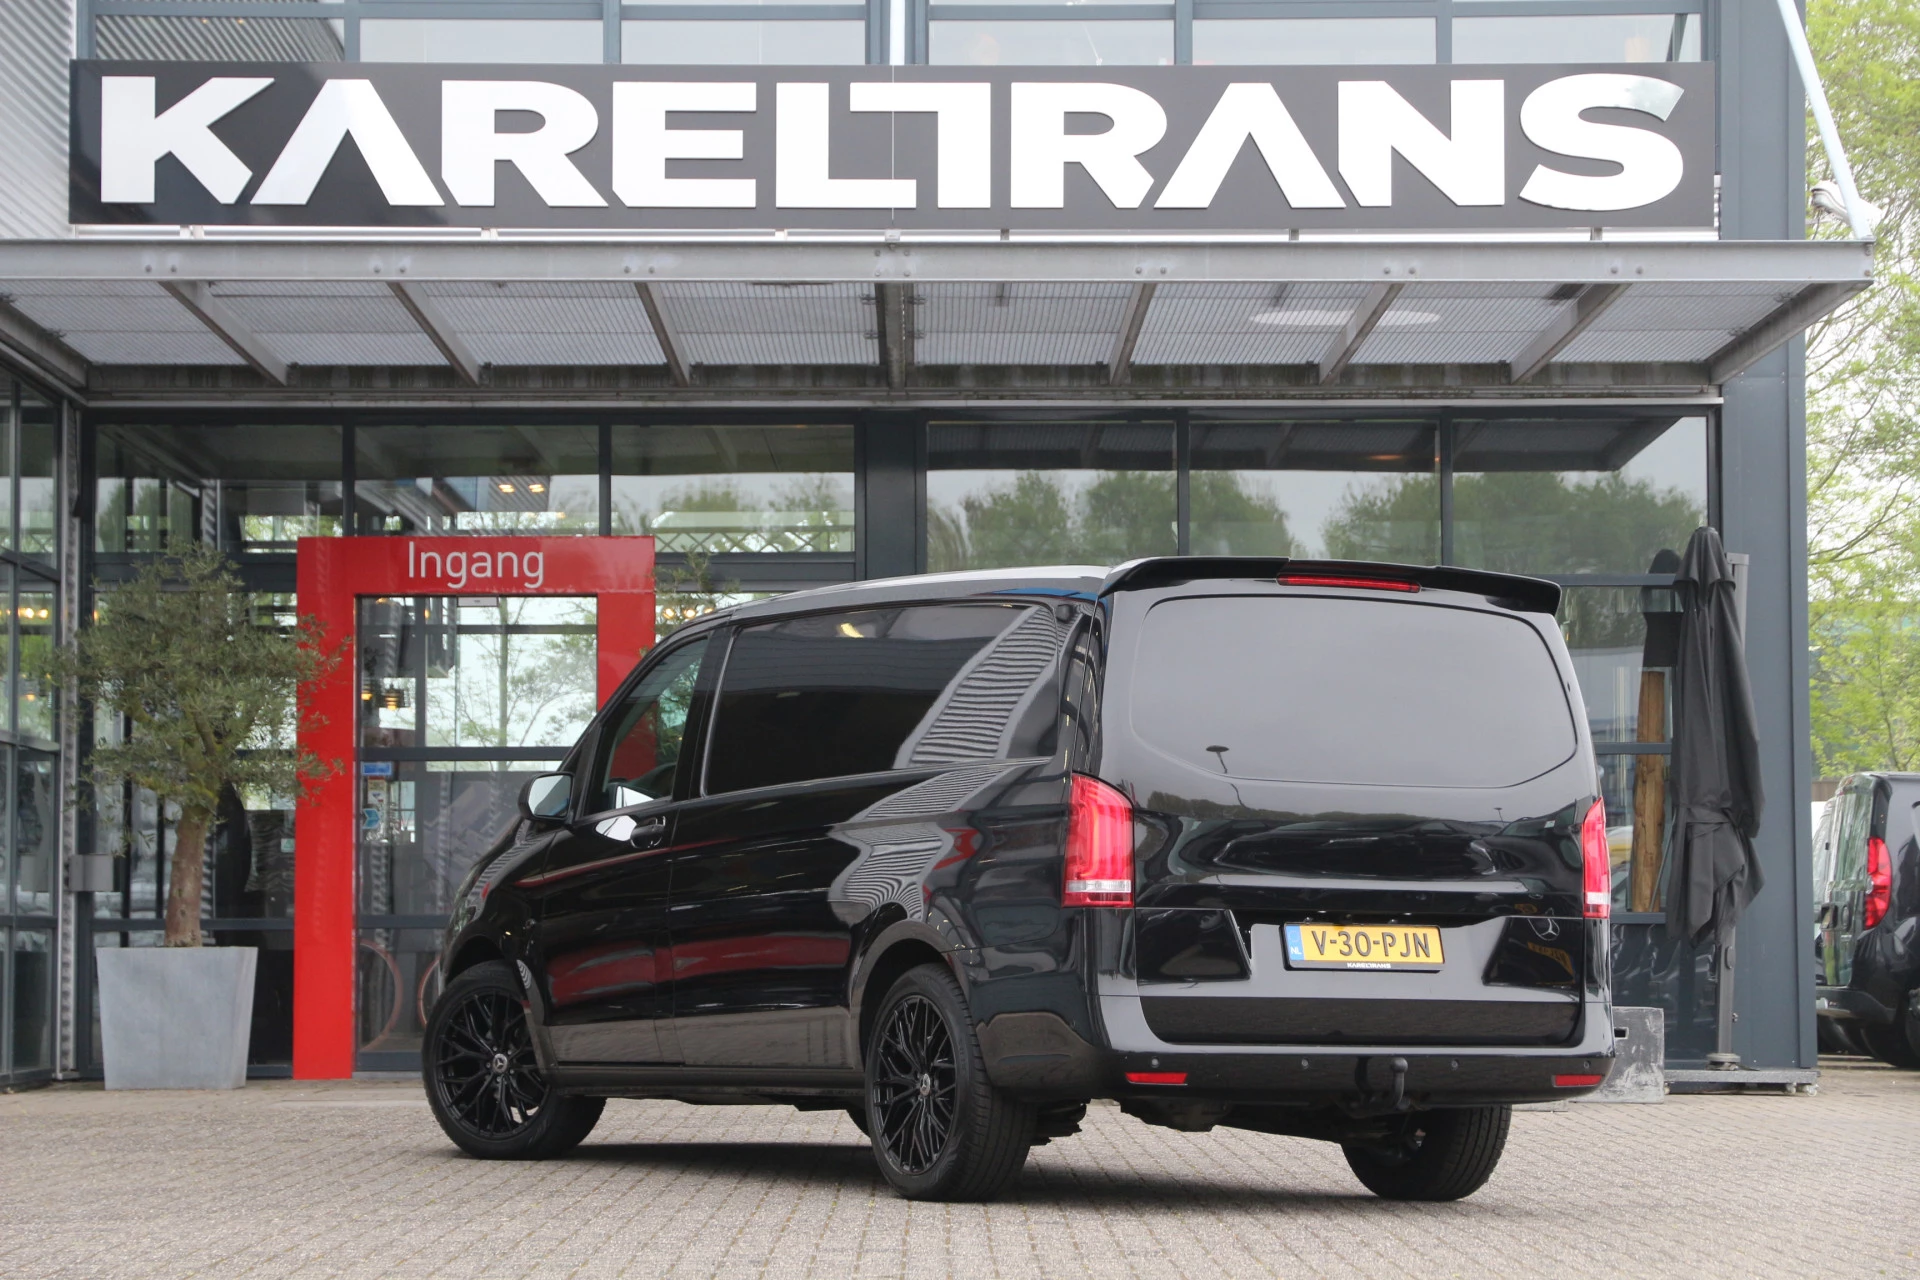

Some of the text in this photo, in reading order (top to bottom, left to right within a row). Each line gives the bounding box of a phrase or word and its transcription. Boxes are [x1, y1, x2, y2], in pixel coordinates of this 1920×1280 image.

[101, 73, 1685, 212] KARELTRANS
[408, 541, 544, 589] Ingang
[1290, 930, 1431, 958] NL V-30-PJN
